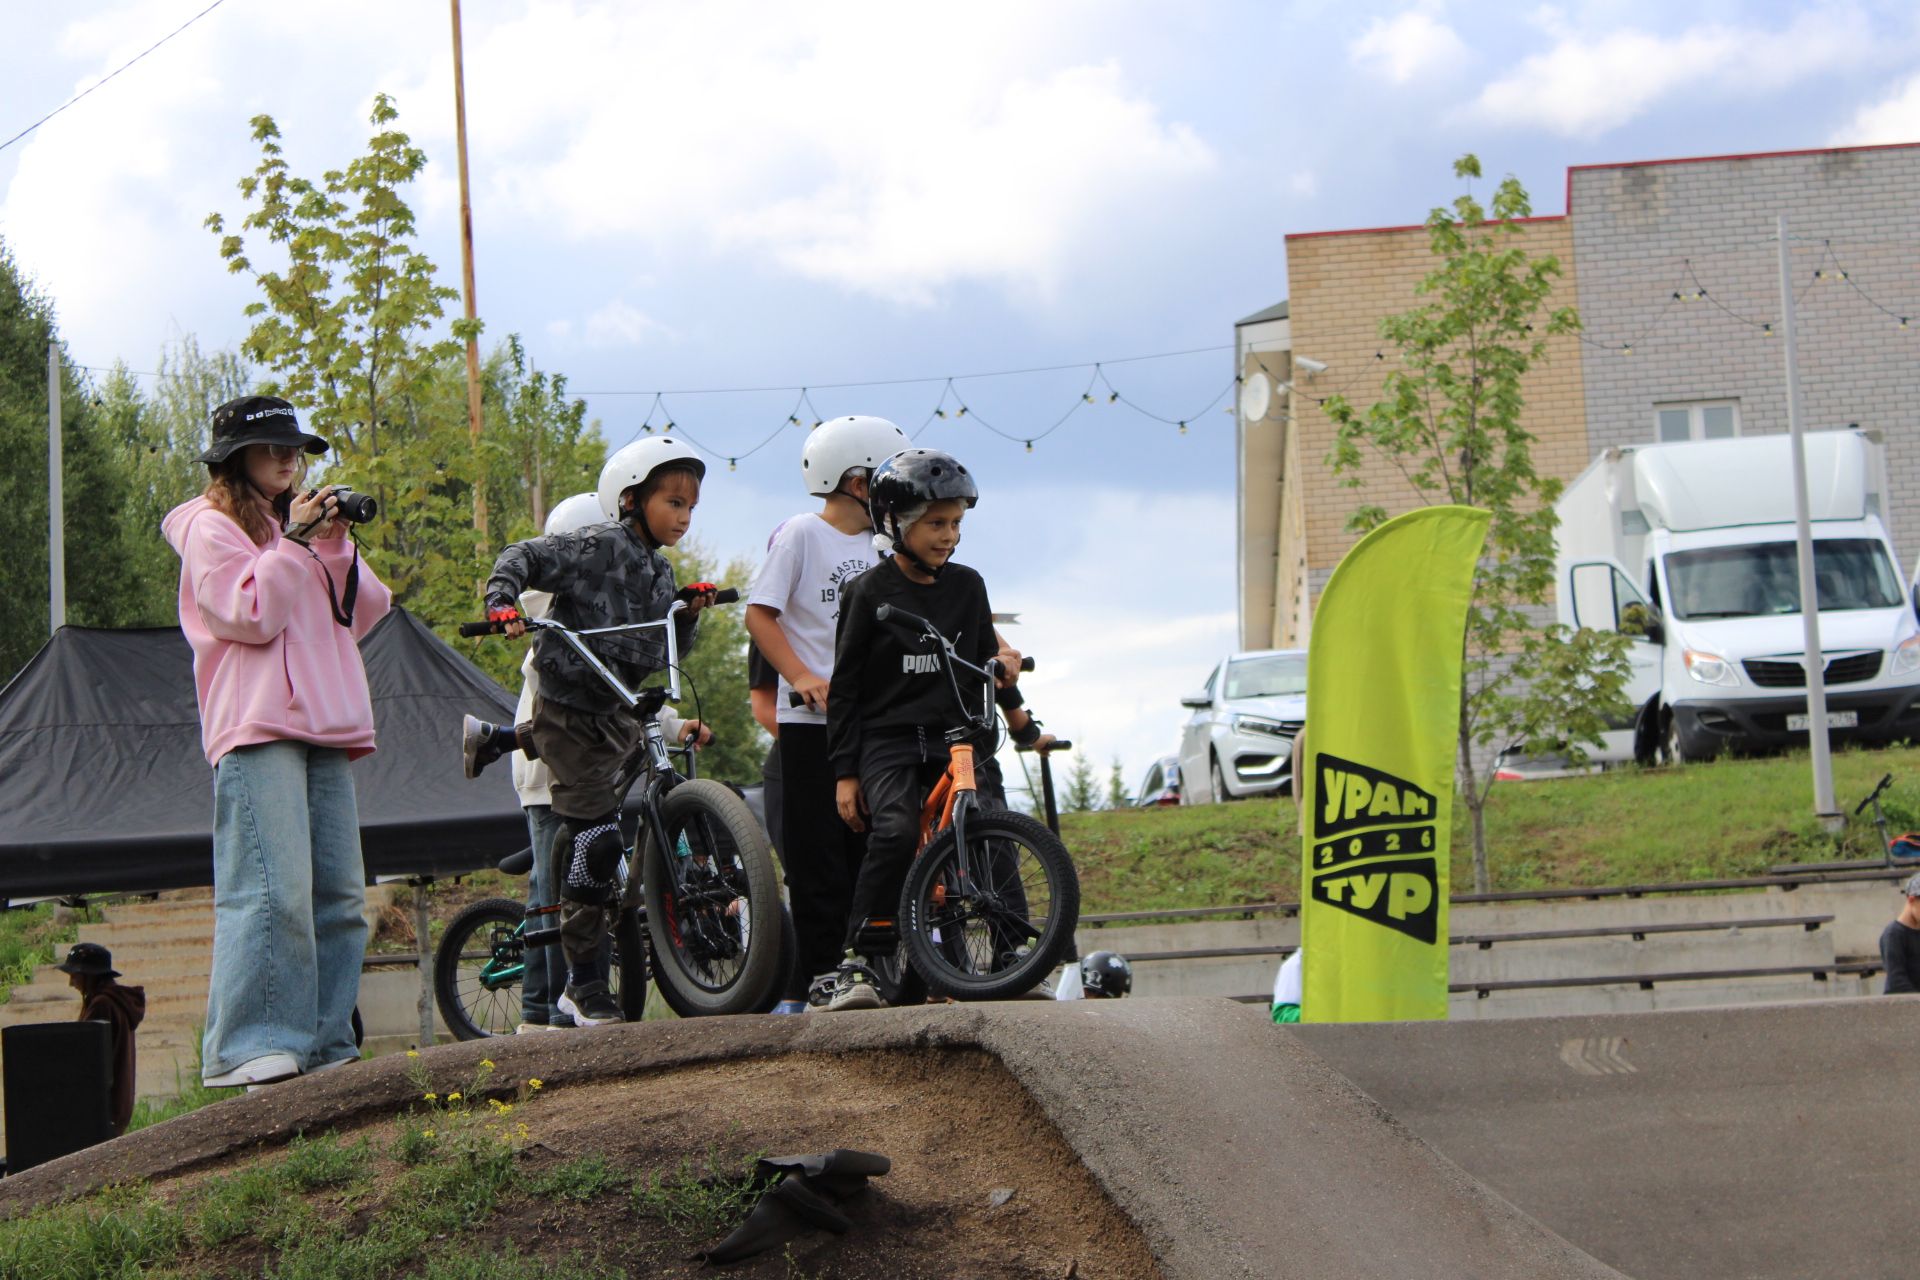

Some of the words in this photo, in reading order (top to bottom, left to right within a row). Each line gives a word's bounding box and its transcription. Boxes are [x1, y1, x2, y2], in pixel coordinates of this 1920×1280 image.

[1323, 768, 1429, 824] УРАМ
[1320, 830, 1431, 864] 2026
[1320, 872, 1432, 920] ТУР
